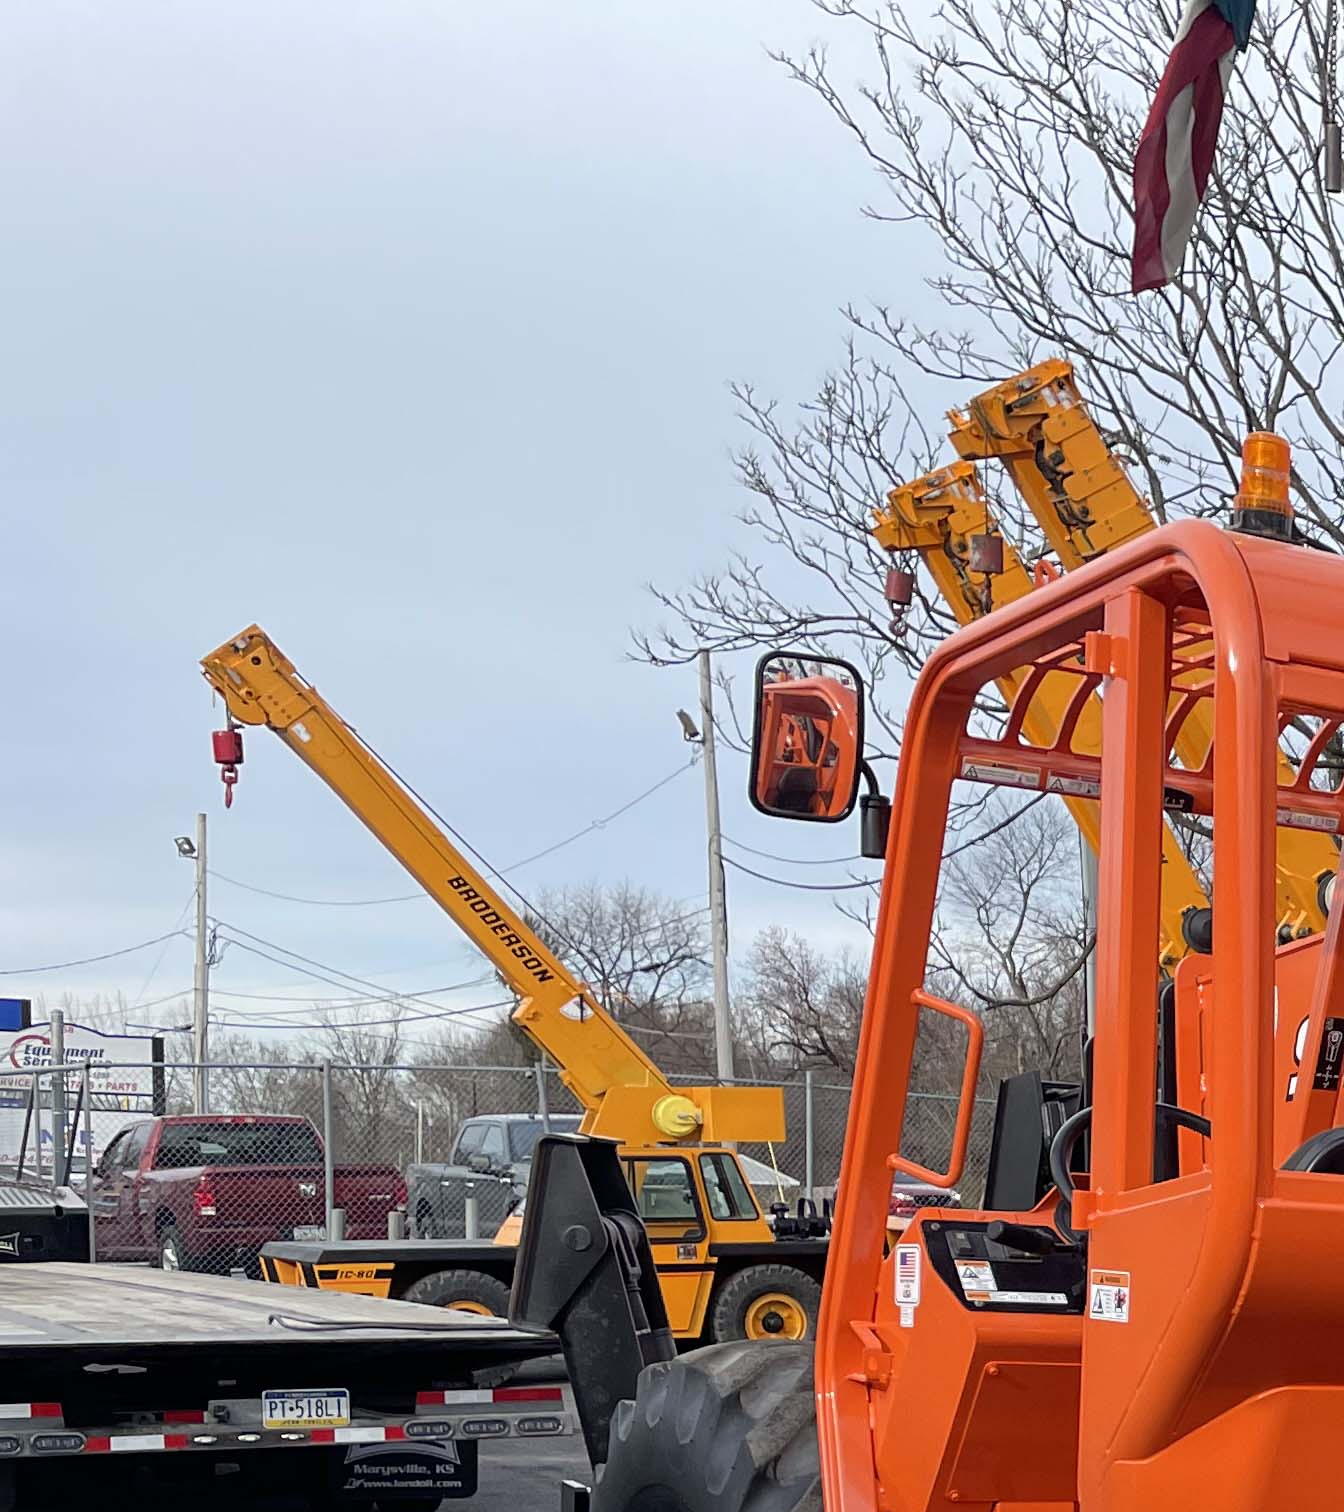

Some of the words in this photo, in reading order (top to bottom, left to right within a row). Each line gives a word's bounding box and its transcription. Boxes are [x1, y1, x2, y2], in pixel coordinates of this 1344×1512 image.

[447, 874, 554, 983] BRODERSON
[23, 1044, 105, 1058] Equment
[353, 1463, 432, 1476] Marysville,
[435, 1463, 456, 1474] KS
